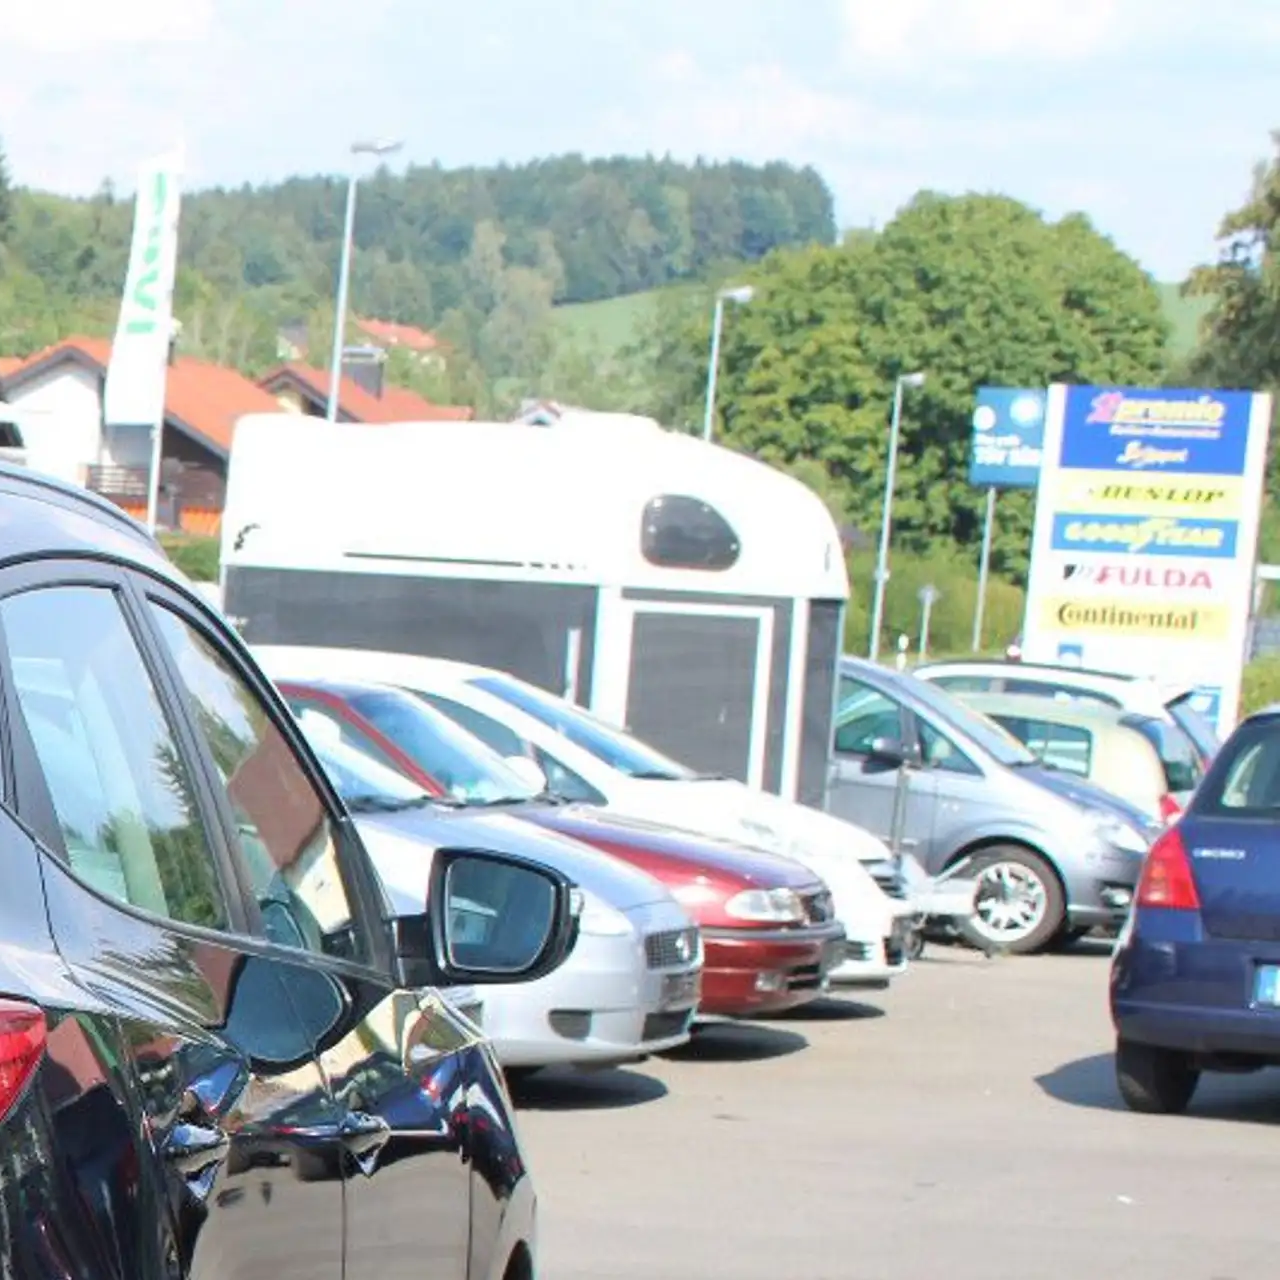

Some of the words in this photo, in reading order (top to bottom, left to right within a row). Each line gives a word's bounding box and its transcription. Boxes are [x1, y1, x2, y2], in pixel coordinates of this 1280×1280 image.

[1101, 485, 1224, 502] DUNLOP
[1095, 565, 1213, 590] FULDA
[1056, 601, 1198, 631] Continental
